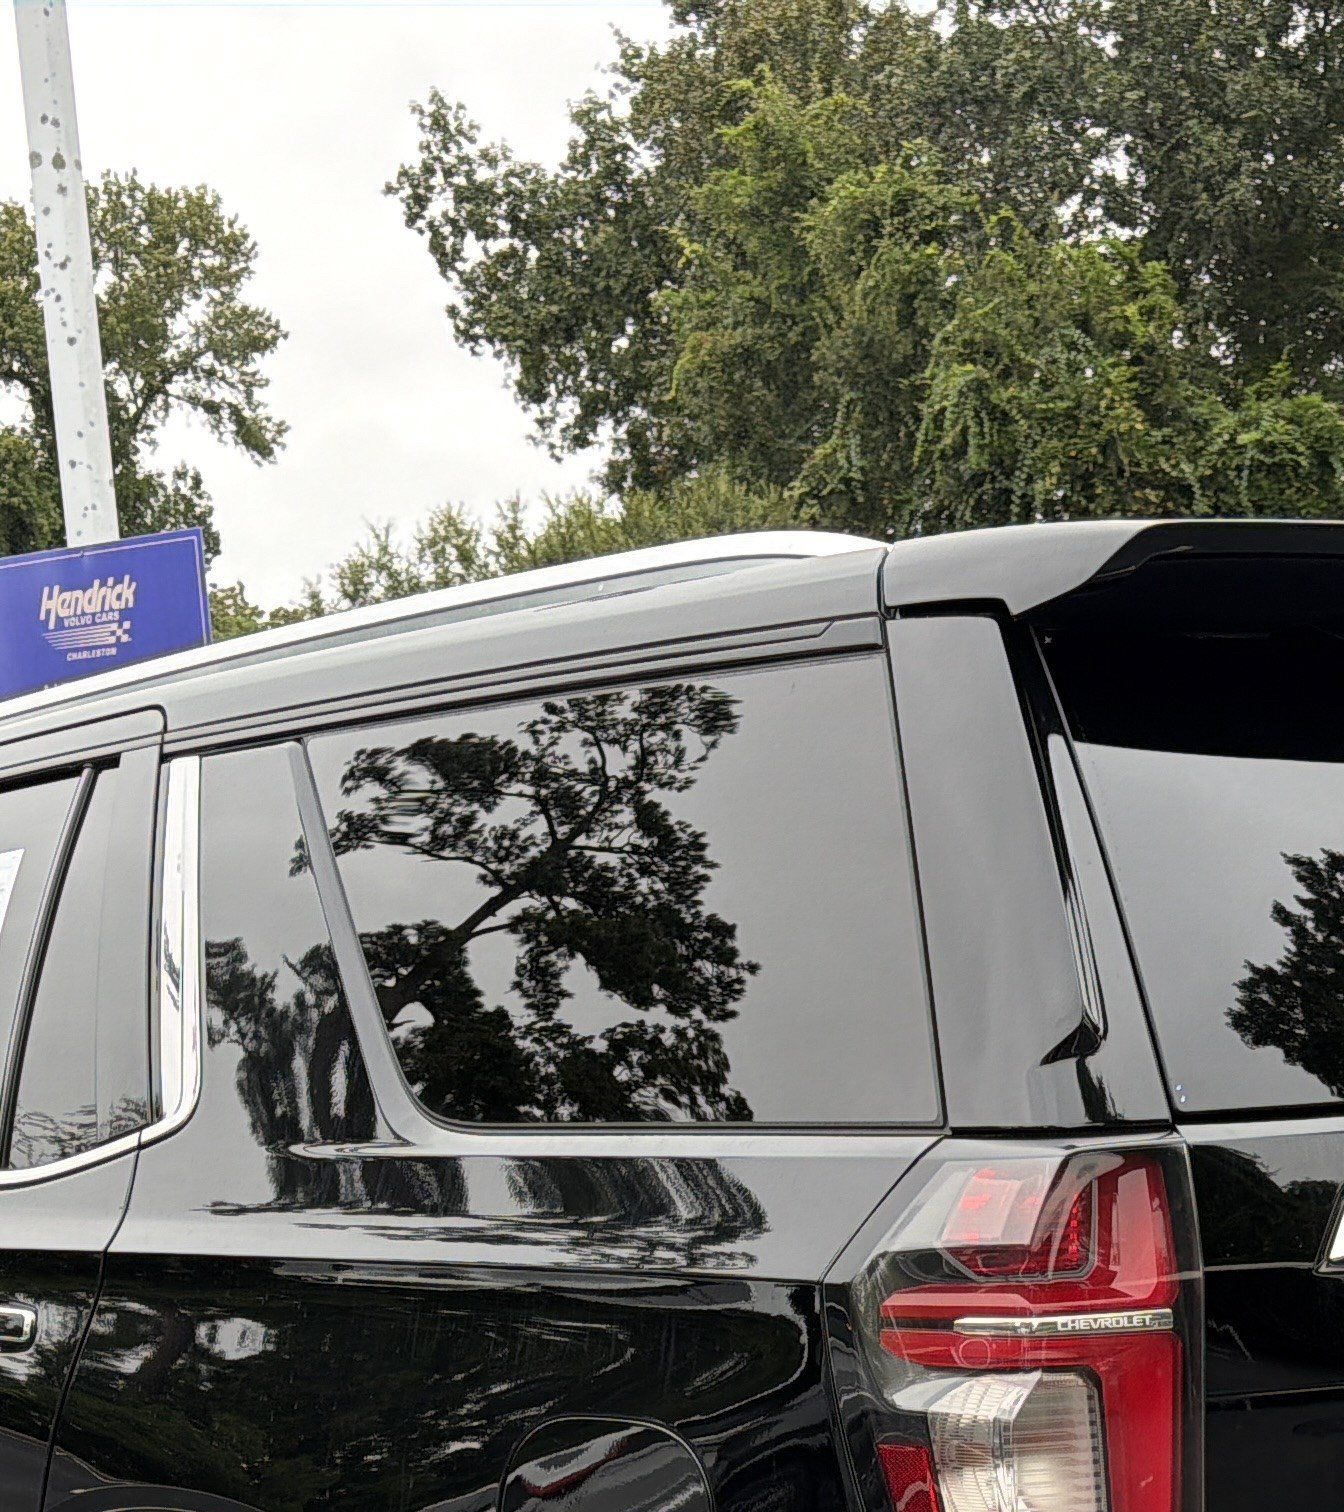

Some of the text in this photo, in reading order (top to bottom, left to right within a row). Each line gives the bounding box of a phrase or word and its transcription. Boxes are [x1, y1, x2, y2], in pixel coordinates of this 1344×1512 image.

[39, 574, 137, 630] Hendrick
[63, 611, 120, 628] VOLVO CARS
[66, 647, 117, 661] CHARLESTON
[1056, 1314, 1153, 1332] CHEVROLET
